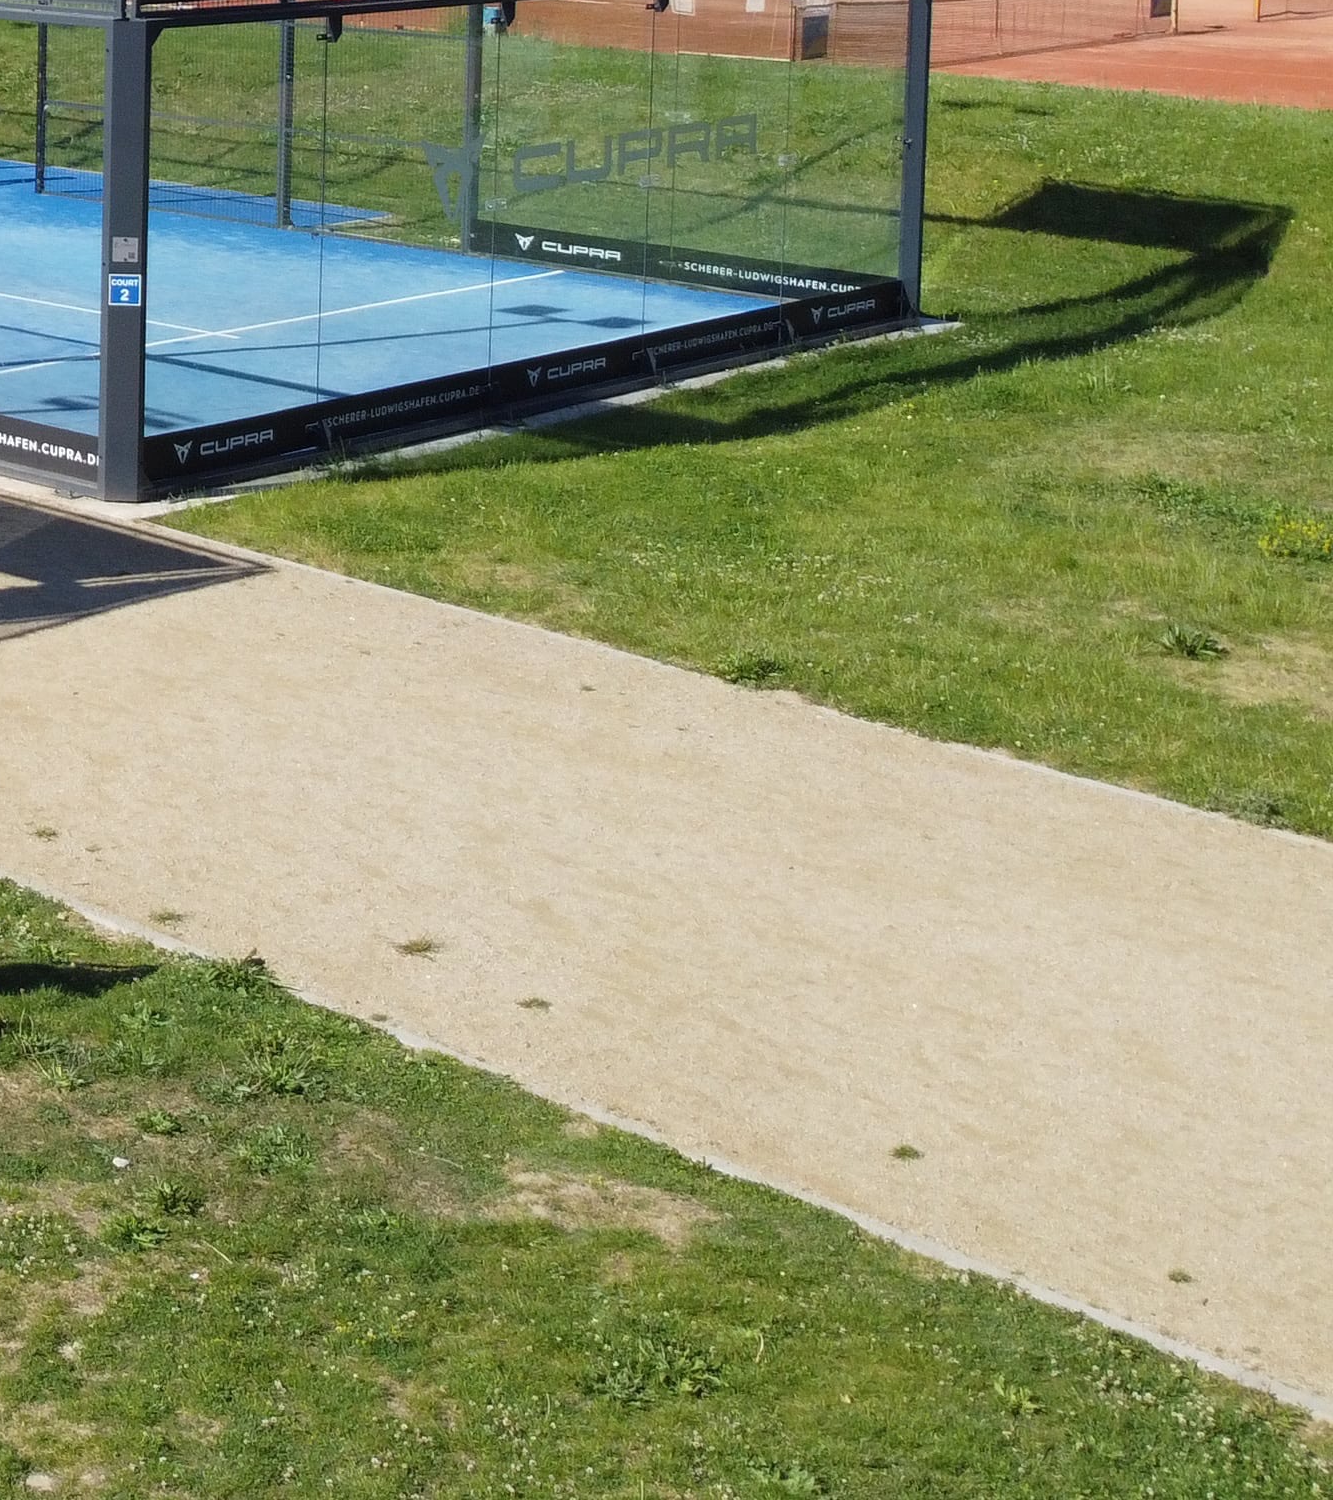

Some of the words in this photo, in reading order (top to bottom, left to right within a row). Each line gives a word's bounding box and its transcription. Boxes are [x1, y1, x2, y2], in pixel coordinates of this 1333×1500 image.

[512, 113, 757, 194] CUPRA
[541, 241, 621, 262] CUPRA
[120, 289, 129, 301] 2
[827, 299, 876, 319] CUPRA
[547, 357, 606, 380] CUPRA
[199, 427, 274, 456] CUPRA
